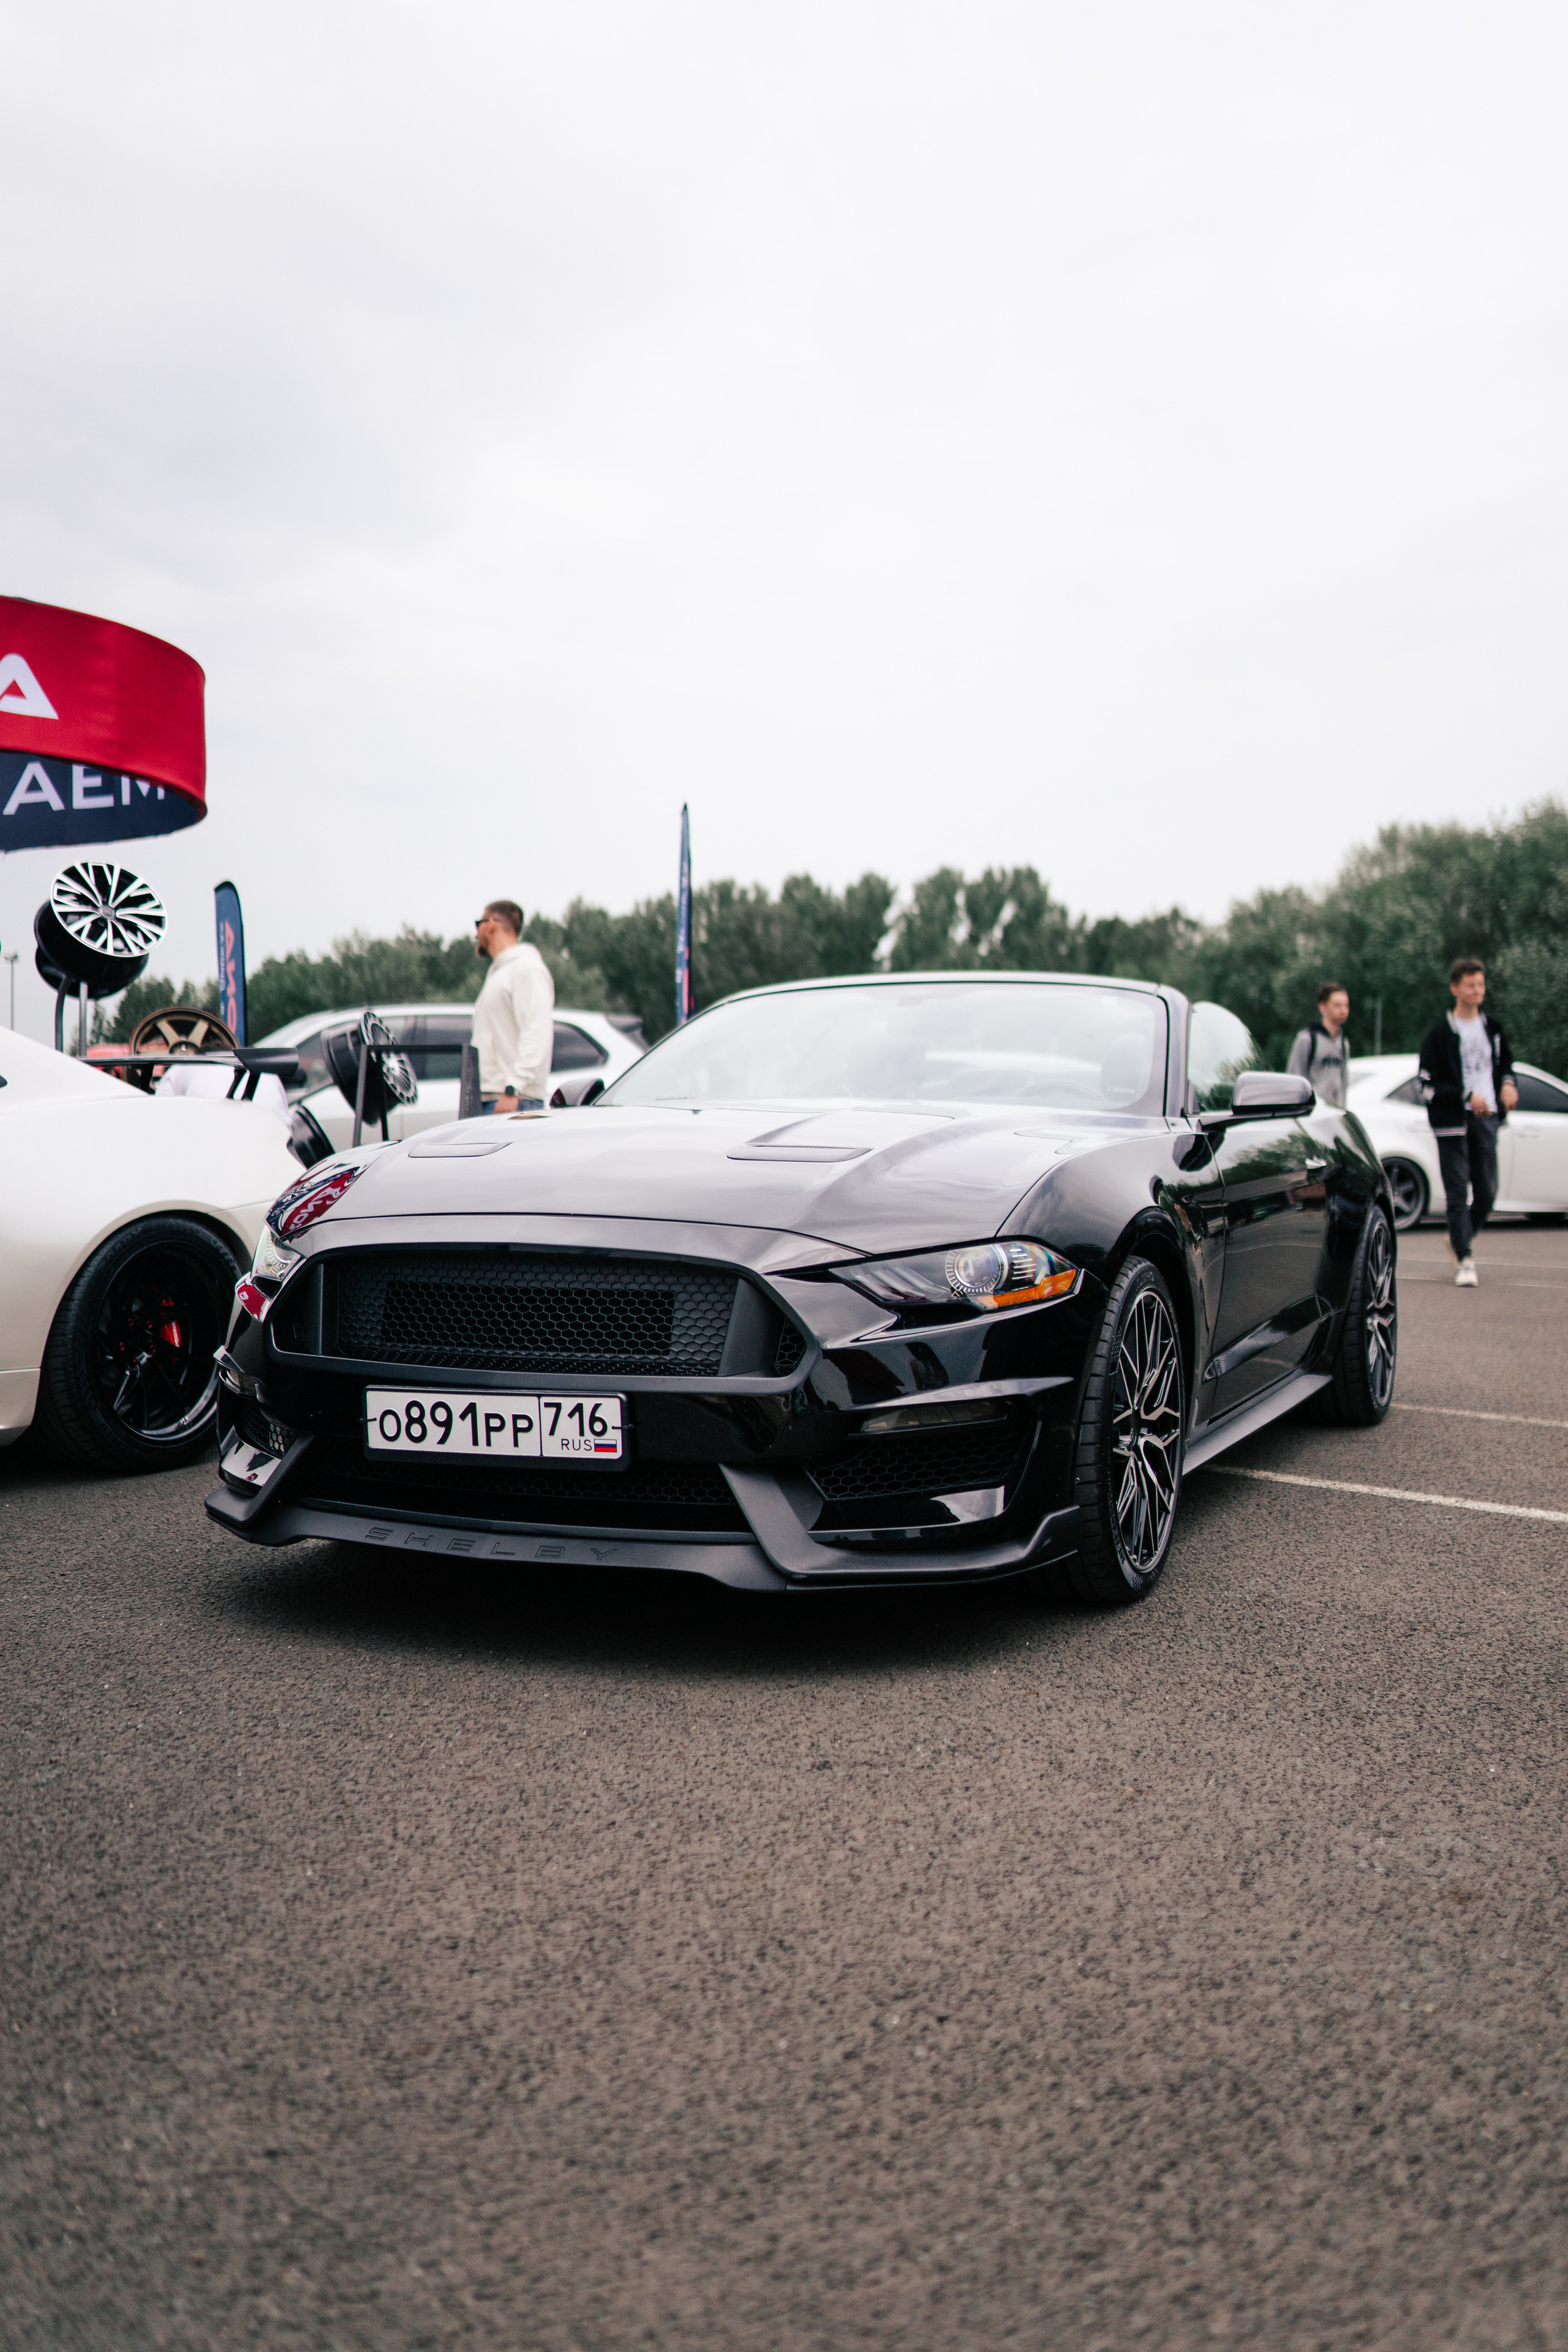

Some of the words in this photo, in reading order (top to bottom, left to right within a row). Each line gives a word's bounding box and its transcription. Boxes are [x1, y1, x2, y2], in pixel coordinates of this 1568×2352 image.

[543, 1401, 609, 1438] 716
[560, 1438, 592, 1452] RUS
[365, 1527, 617, 1560] SHELBY
